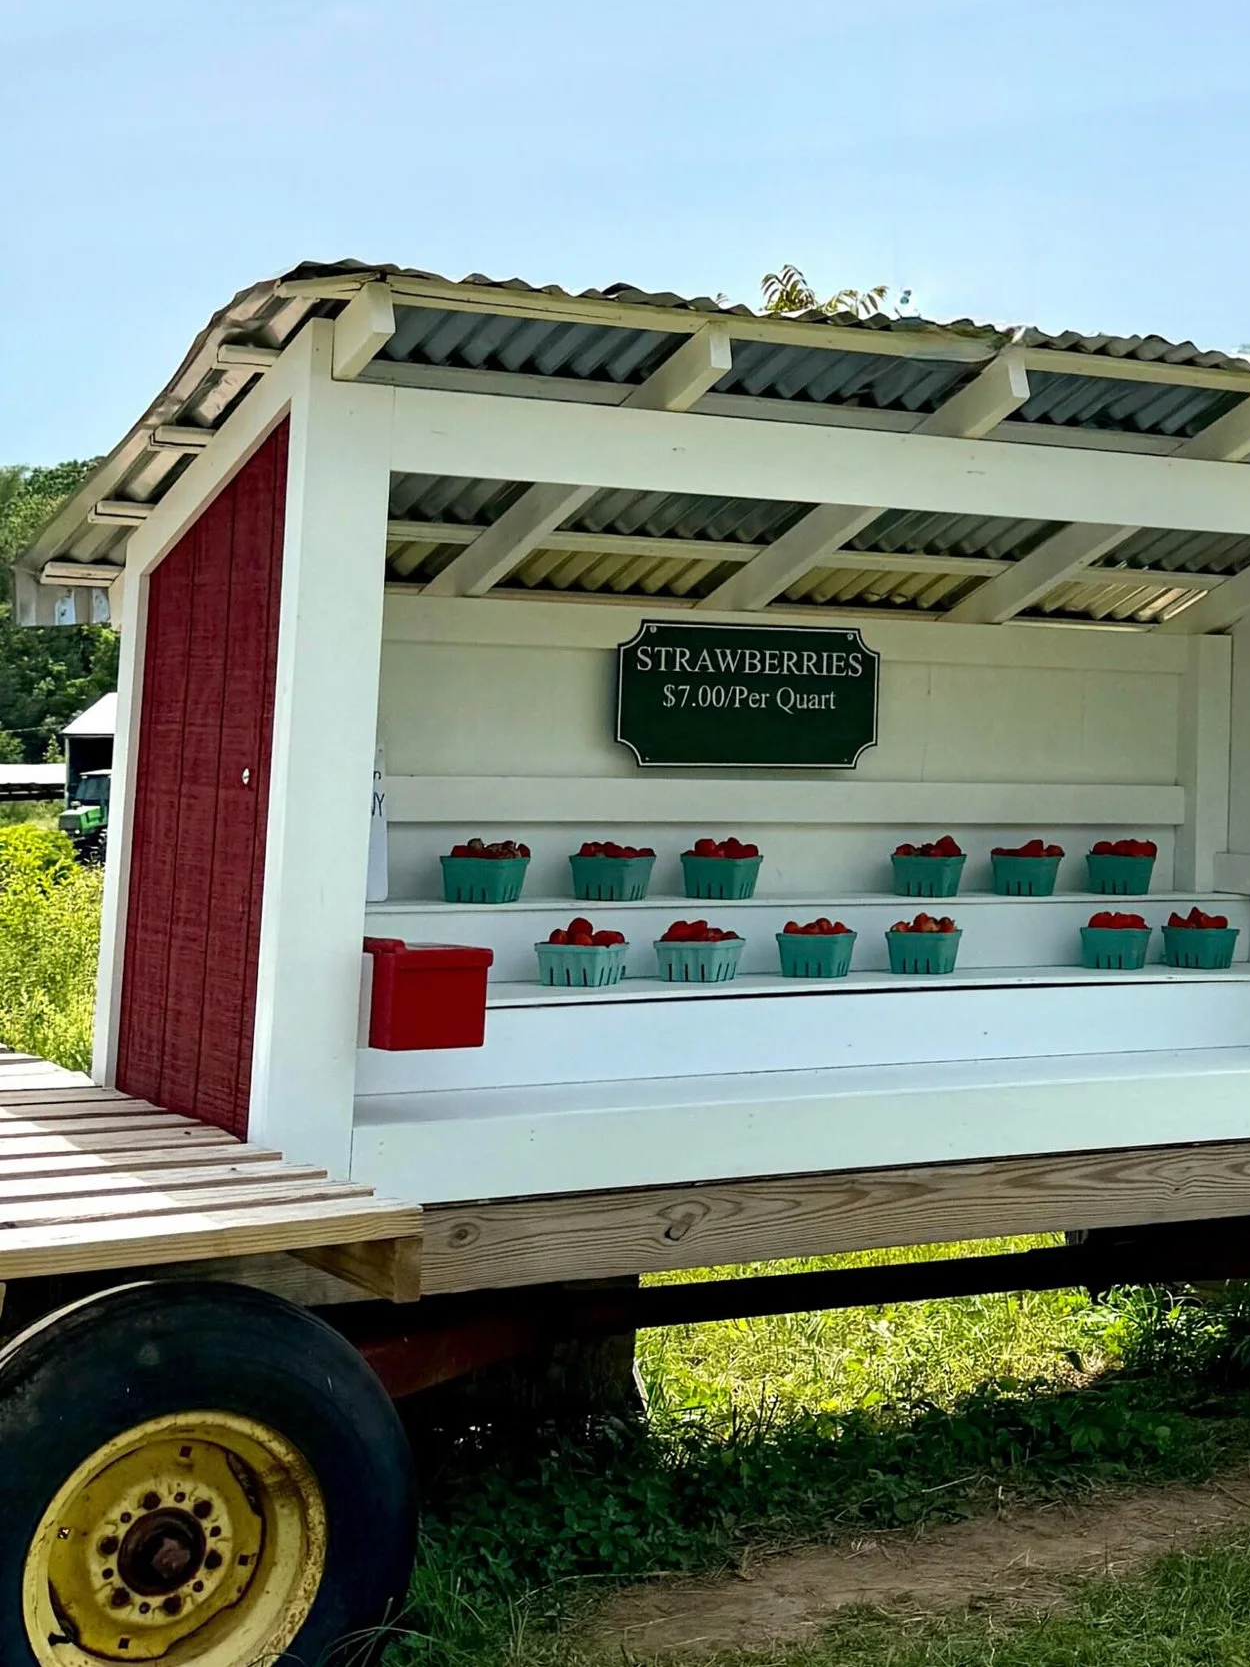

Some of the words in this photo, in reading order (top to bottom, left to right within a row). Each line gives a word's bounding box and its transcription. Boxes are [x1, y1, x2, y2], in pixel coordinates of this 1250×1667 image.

[636, 646, 862, 676] STRAWBERRIES
[663, 684, 769, 708] $7.00/Per
[776, 687, 836, 714] Quart
